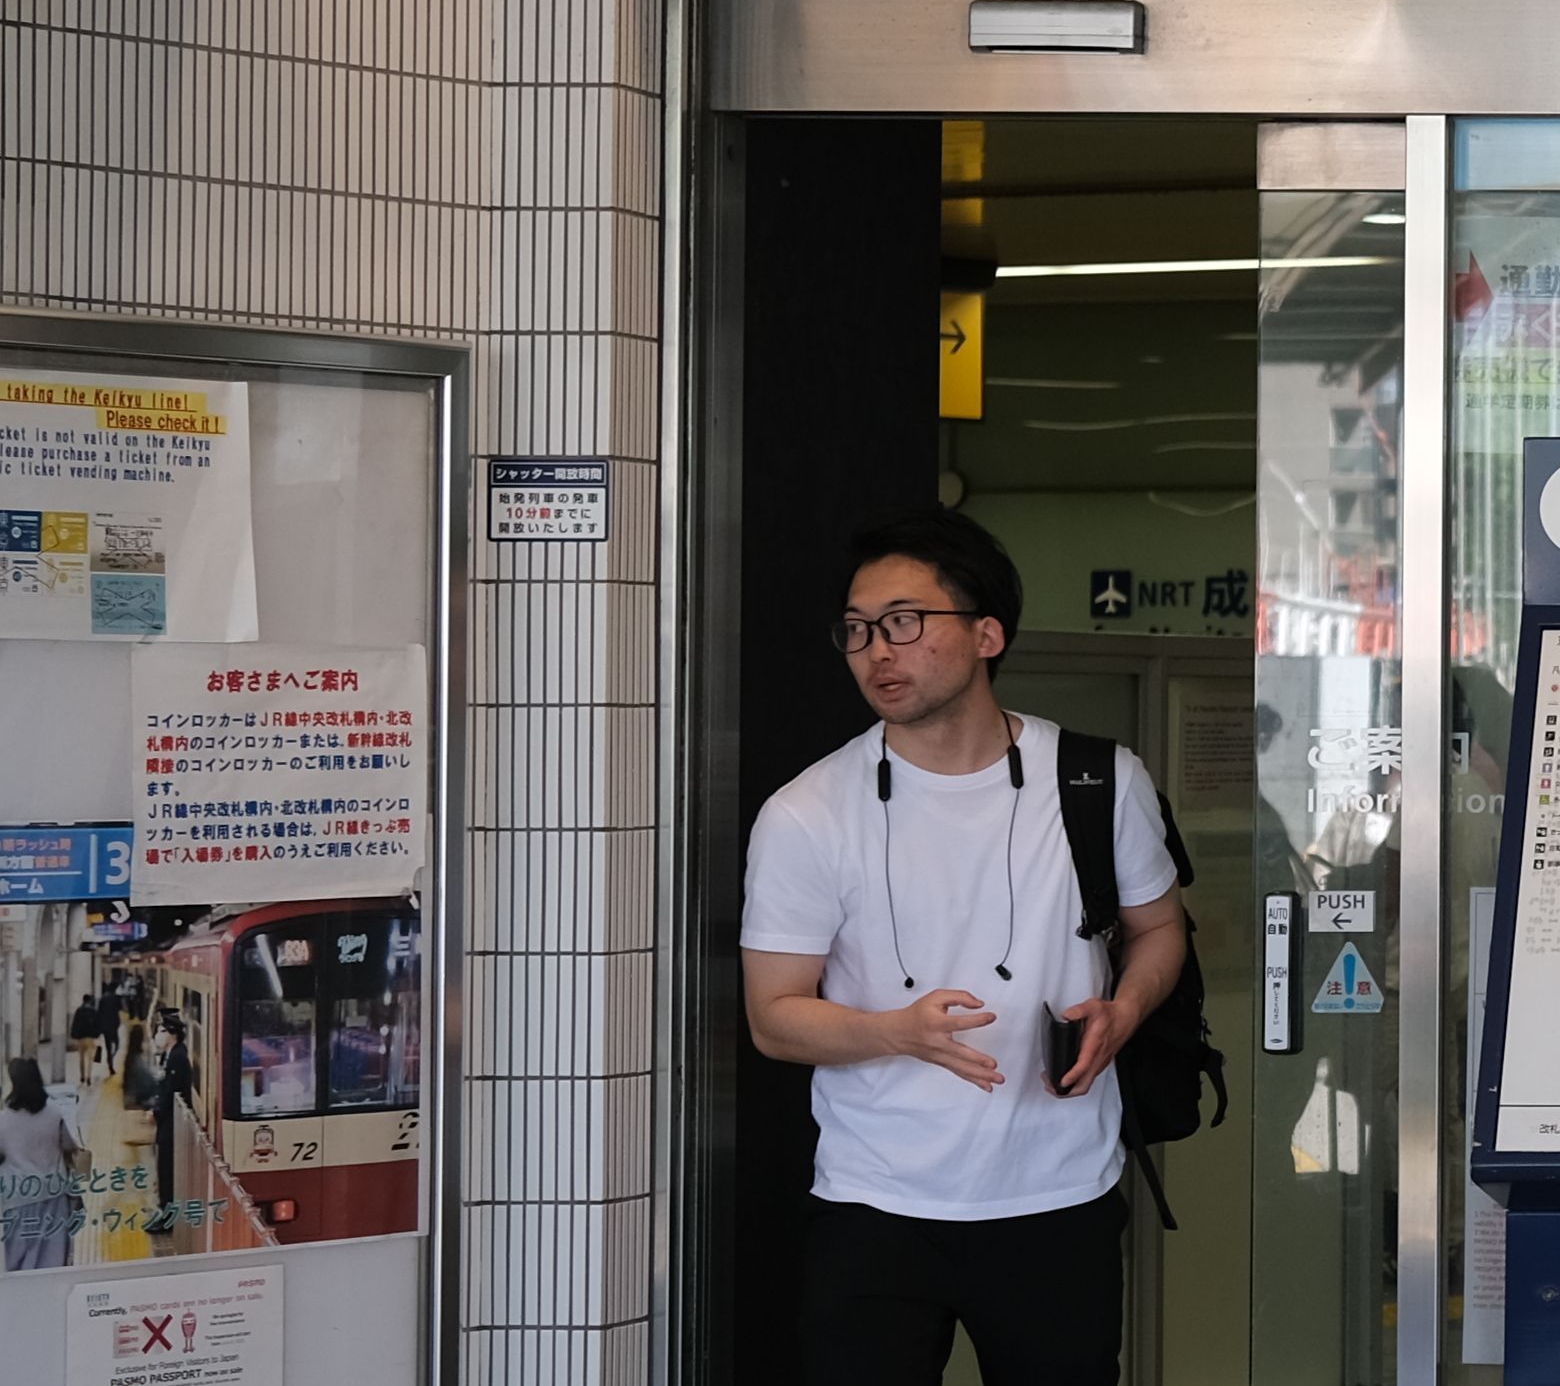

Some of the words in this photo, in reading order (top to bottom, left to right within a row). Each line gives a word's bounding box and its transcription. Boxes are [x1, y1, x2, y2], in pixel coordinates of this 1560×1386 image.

[8, 384, 53, 404] taking
[64, 388, 85, 404] the
[94, 390, 142, 408] Keikyu
[106, 411, 152, 428] Please
[158, 415, 196, 431] check
[1138, 582, 1194, 607] NRT
[207, 670, 358, 692] お客さまへご案内
[1317, 895, 1365, 909] PUSH
[1268, 909, 1288, 920] AUTO
[1268, 924, 1288, 935] 自動
[1267, 967, 1287, 979] PUSH
[290, 1142, 318, 1161] 72
